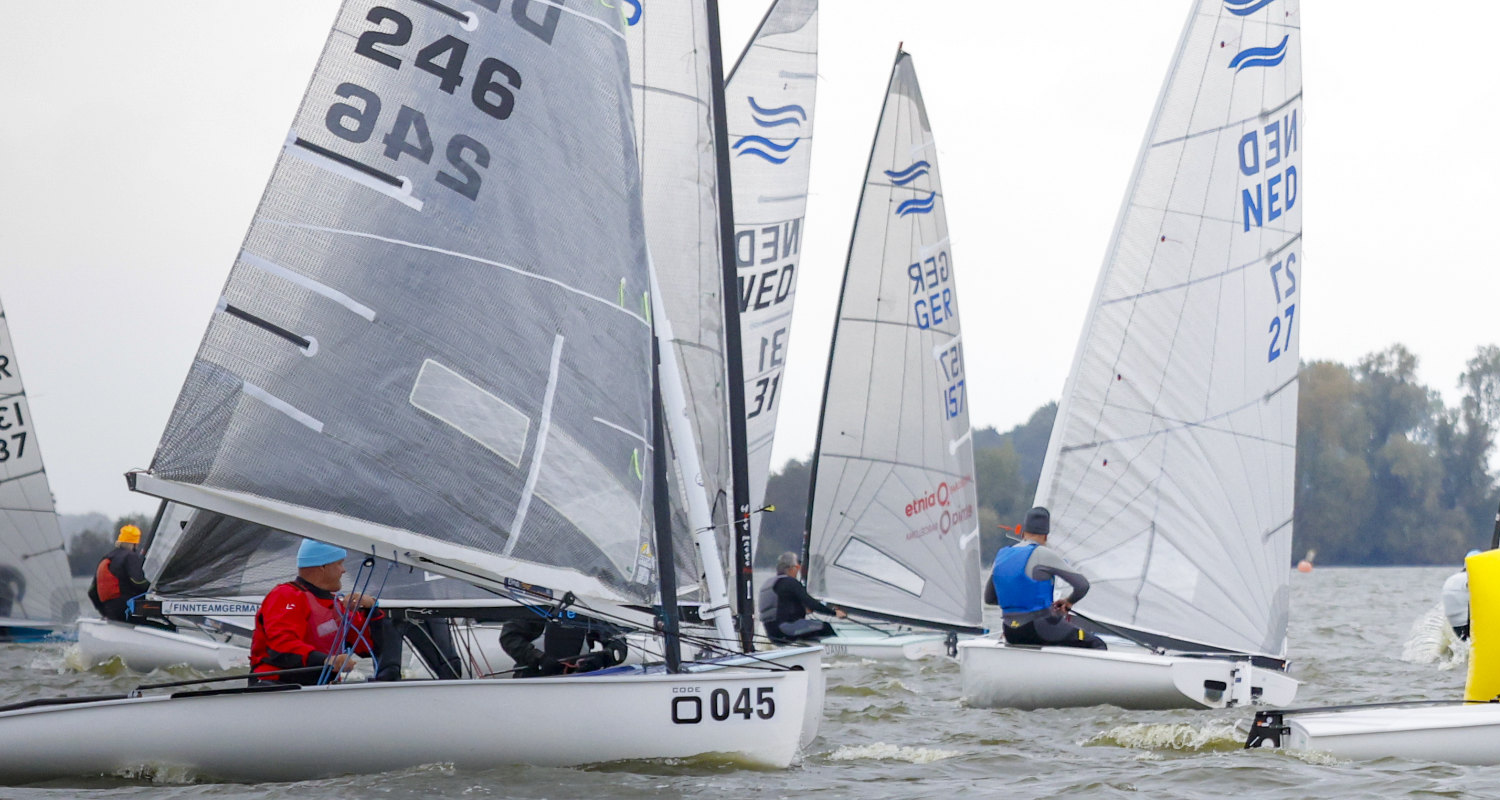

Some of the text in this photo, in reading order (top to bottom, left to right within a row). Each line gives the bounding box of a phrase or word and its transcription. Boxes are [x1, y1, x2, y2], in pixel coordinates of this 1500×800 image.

[354, 6, 522, 120] 246
[1242, 165, 1297, 233] NED
[914, 287, 953, 331] GER
[1267, 303, 1296, 363] 27
[747, 371, 781, 420] 31
[943, 380, 965, 421] 157
[0, 431, 27, 463] 37
[710, 686, 775, 722] 045
